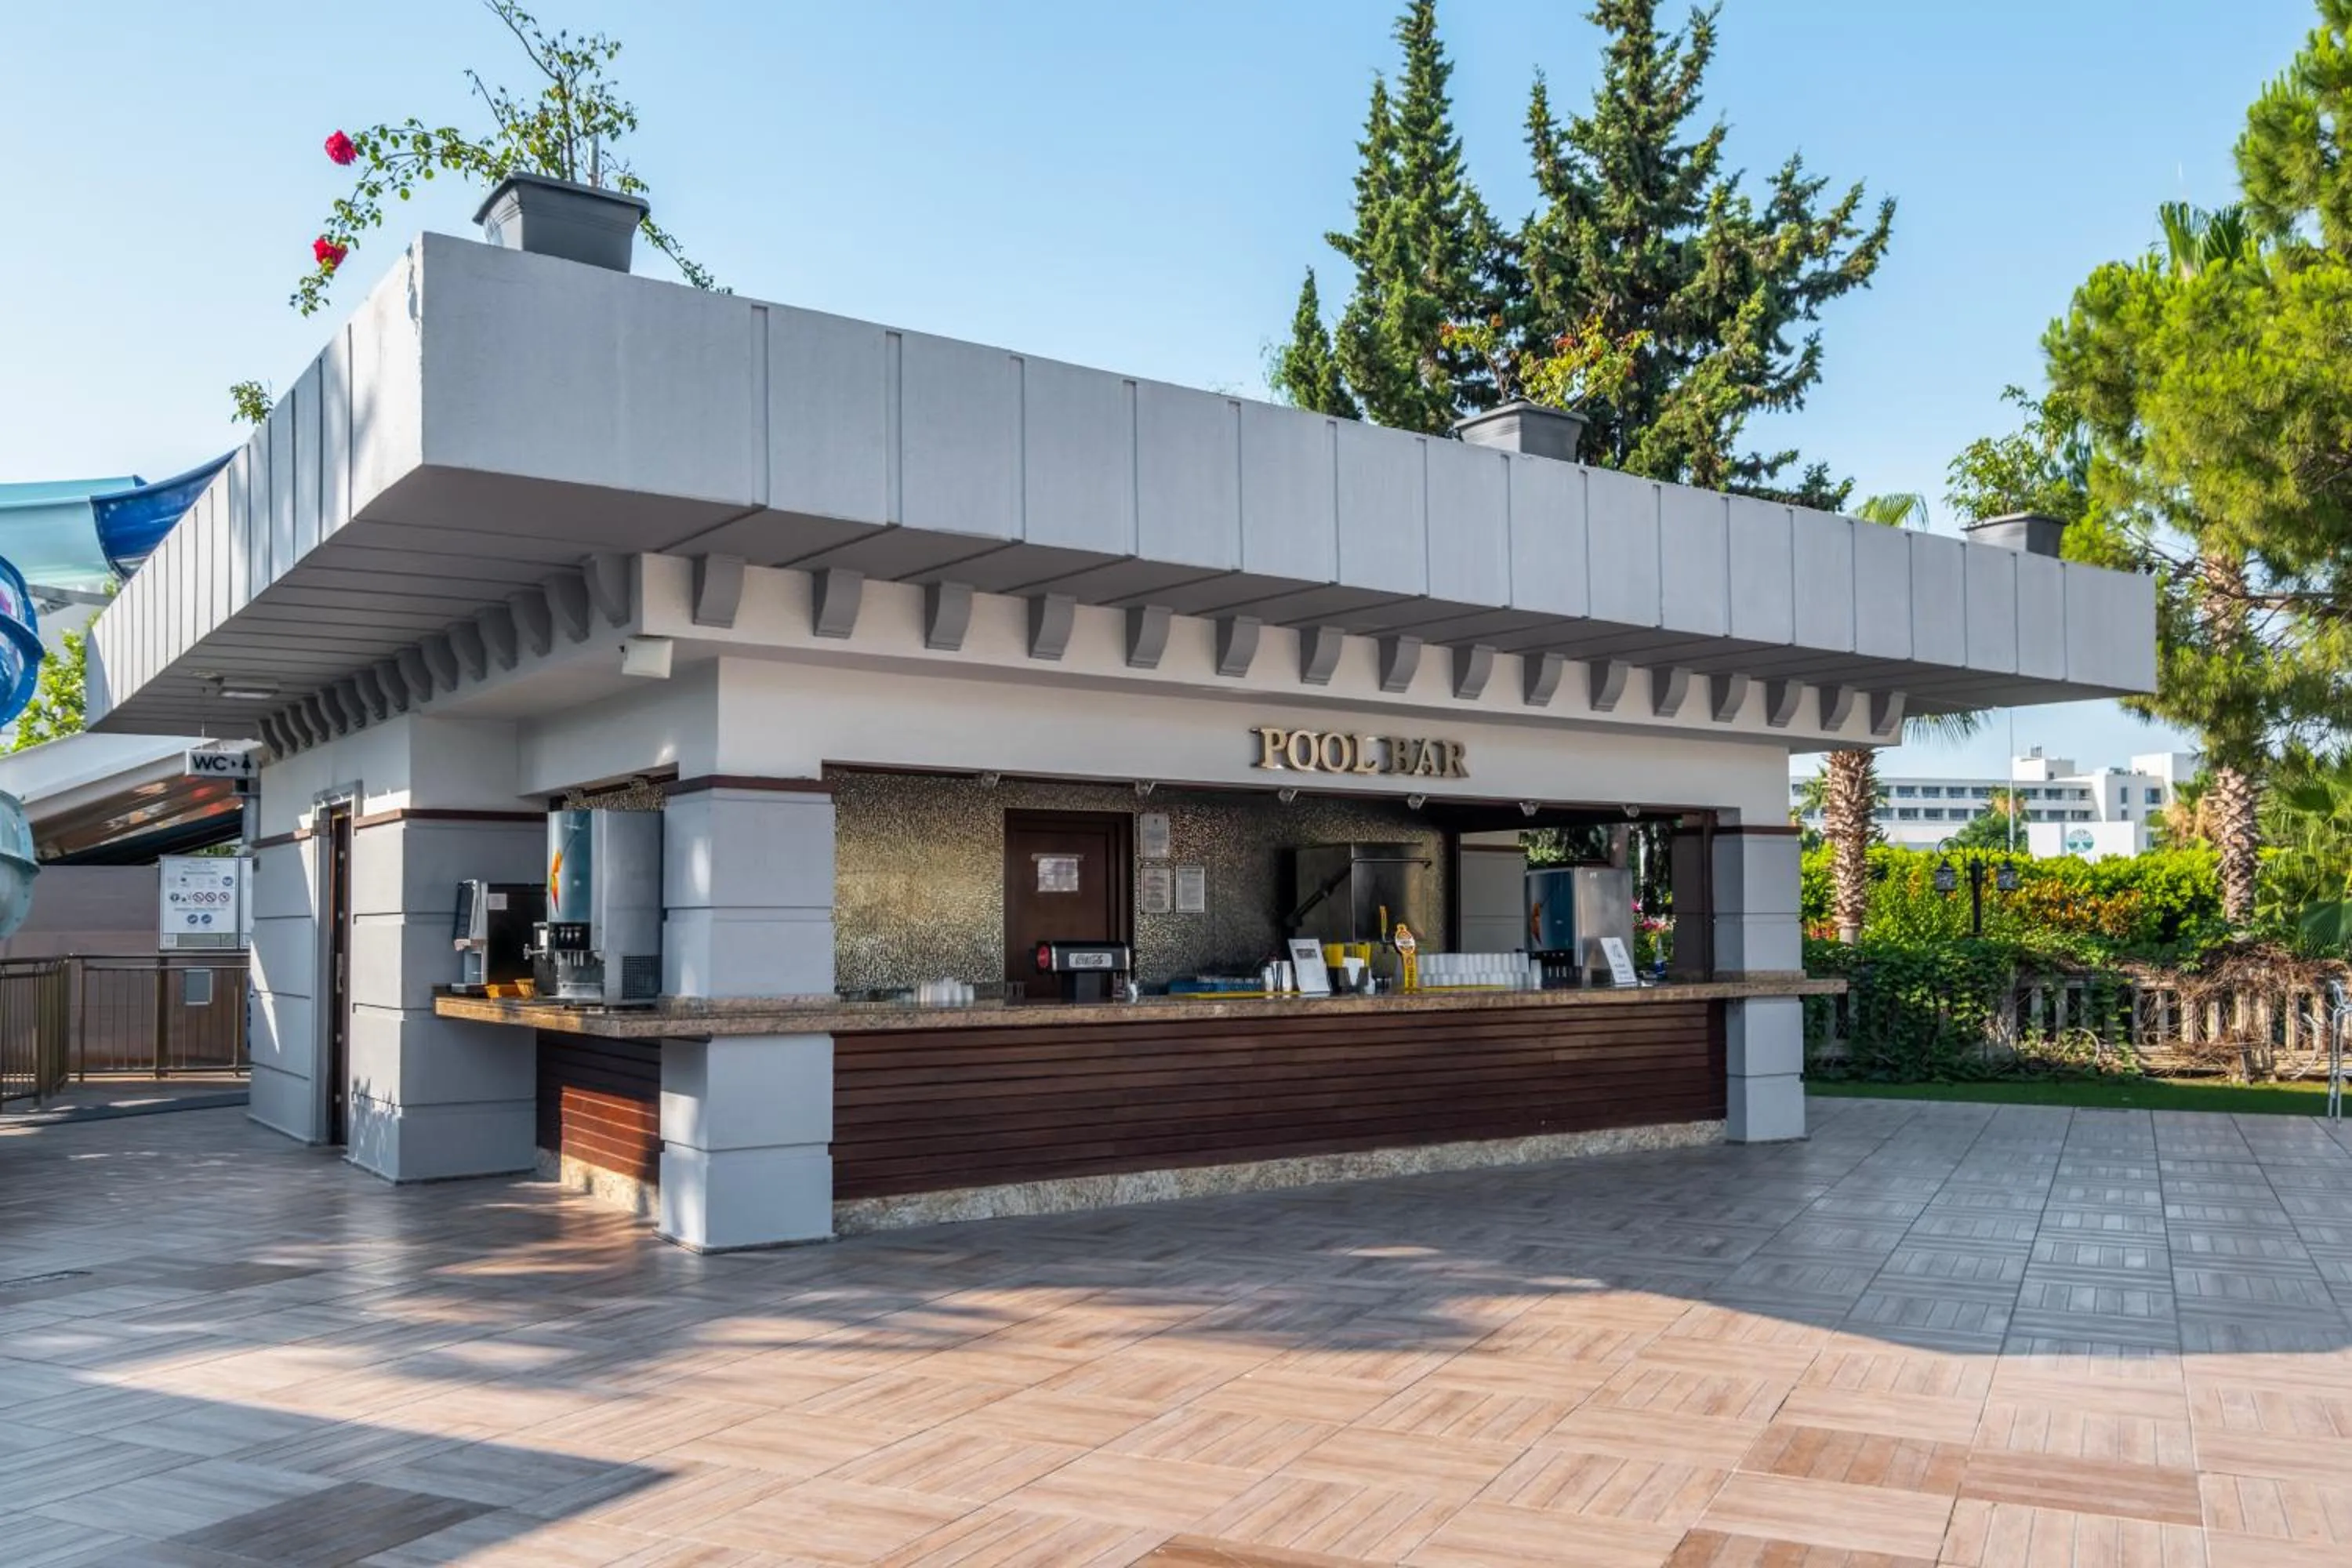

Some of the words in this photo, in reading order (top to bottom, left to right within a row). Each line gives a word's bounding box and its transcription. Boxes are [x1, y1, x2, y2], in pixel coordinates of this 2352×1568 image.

[192, 756, 228, 771] WC
[1256, 727, 1380, 775] POOL
[1390, 735, 1471, 779] BAR
